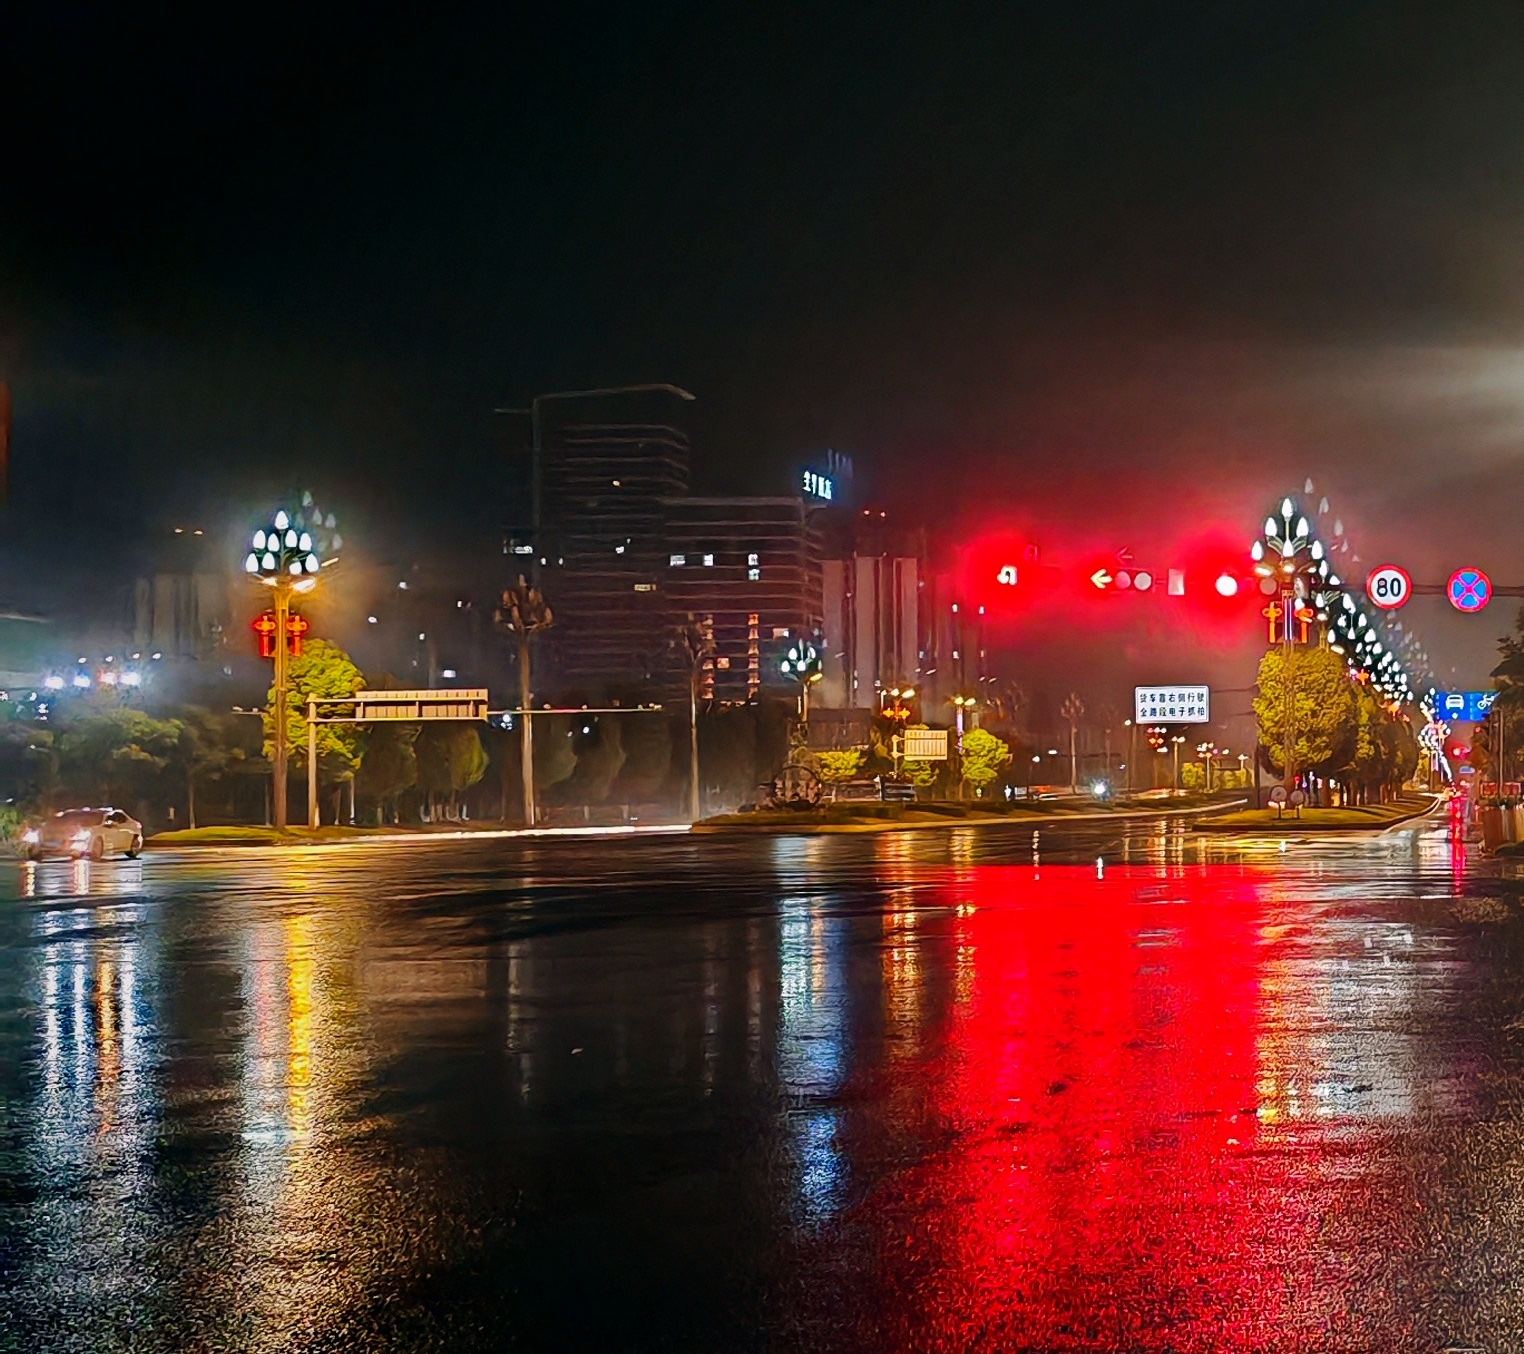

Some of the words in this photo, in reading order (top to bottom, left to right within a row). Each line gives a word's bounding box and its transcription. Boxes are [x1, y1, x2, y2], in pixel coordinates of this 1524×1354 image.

[1377, 578, 1401, 597] 80
[1140, 706, 1205, 717] 全路段电子抓拍
